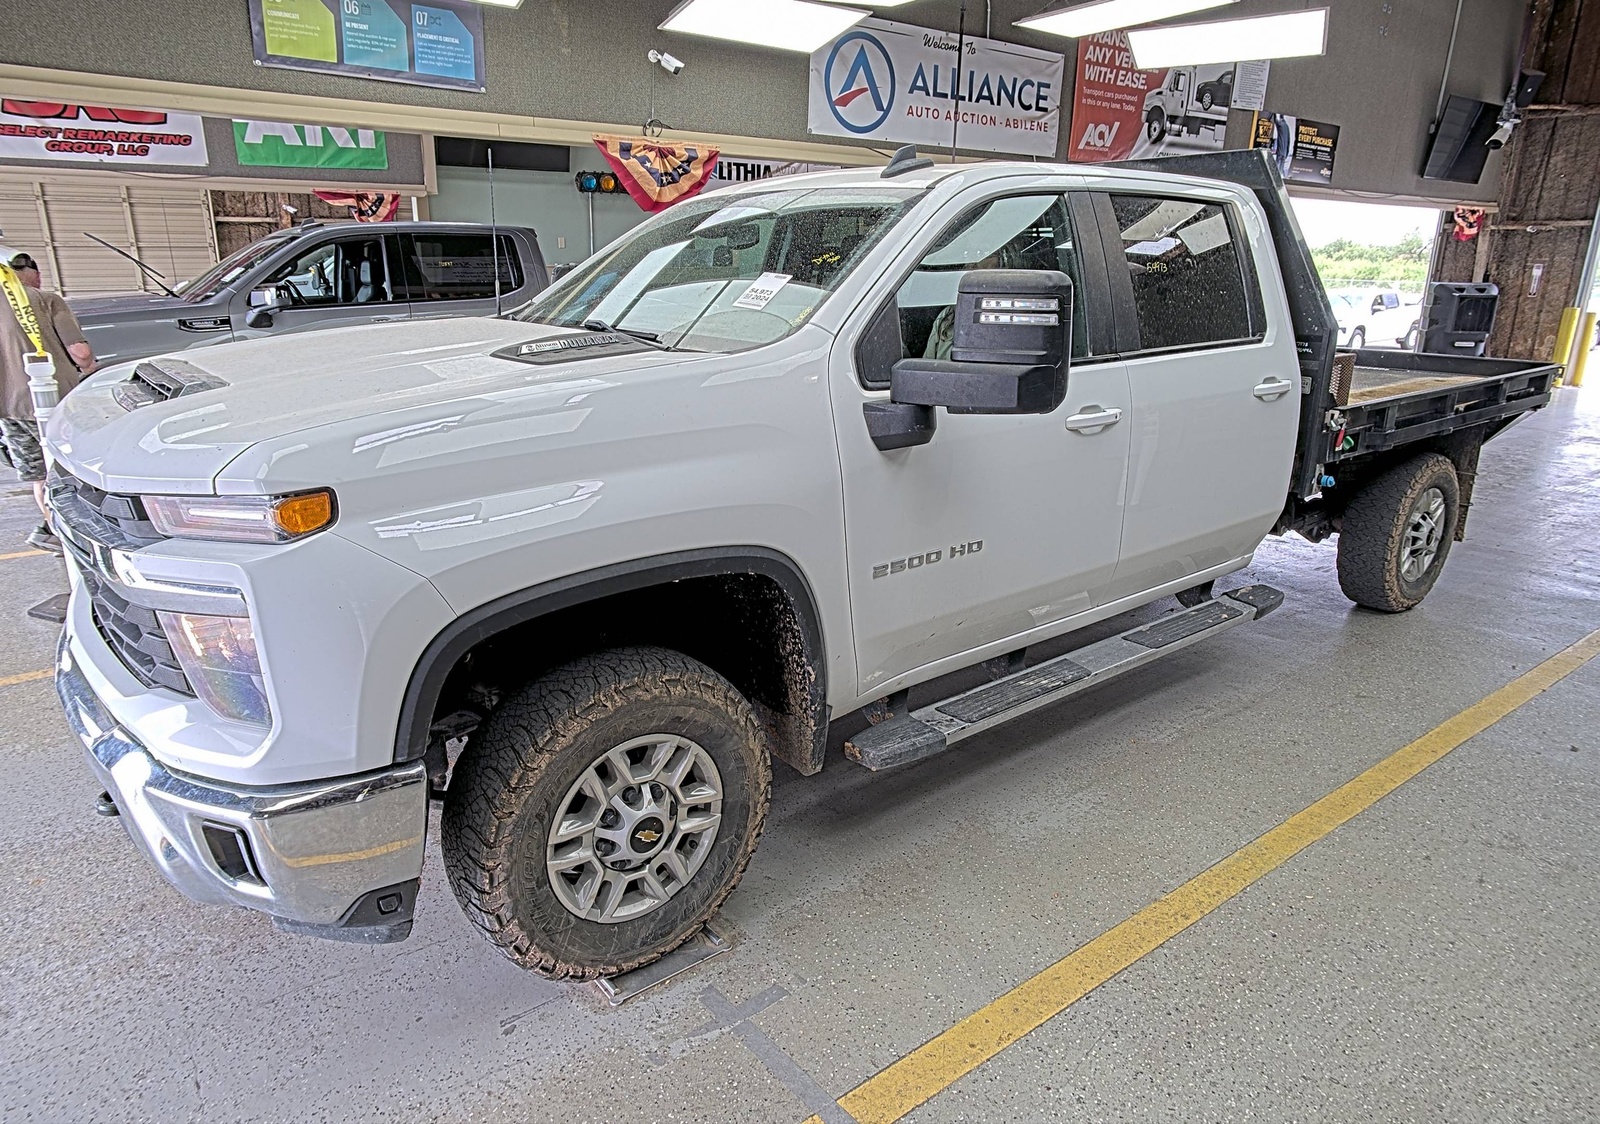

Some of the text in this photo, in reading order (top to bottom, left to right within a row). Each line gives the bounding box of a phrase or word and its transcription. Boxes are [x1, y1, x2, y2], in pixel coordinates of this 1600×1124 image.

[344, 0, 359, 15] 06
[416, 11, 428, 26] 07
[416, 32, 439, 40] PLACEMENT
[923, 33, 977, 55] Welcome To
[1084, 45, 1114, 65] ANY
[1085, 64, 1148, 90] WITH EASE.
[908, 62, 1051, 113] ALLIANCE
[1083, 86, 1104, 97] Transport
[1115, 92, 1138, 102] purchased
[1087, 97, 1096, 105] this
[1102, 101, 1110, 109] any
[906, 105, 940, 120] AUTO
[945, 109, 997, 127] AUCTION
[1004, 117, 1049, 133] ABILENE
[0, 124, 192, 146] SELECT REMARKETING
[1077, 121, 1121, 150] ACV
[45, 140, 150, 156] GROUP, LLC
[718, 160, 773, 181] LITHIA
[560, 334, 620, 349] DURAMAX
[872, 539, 983, 579] 2500 HD
